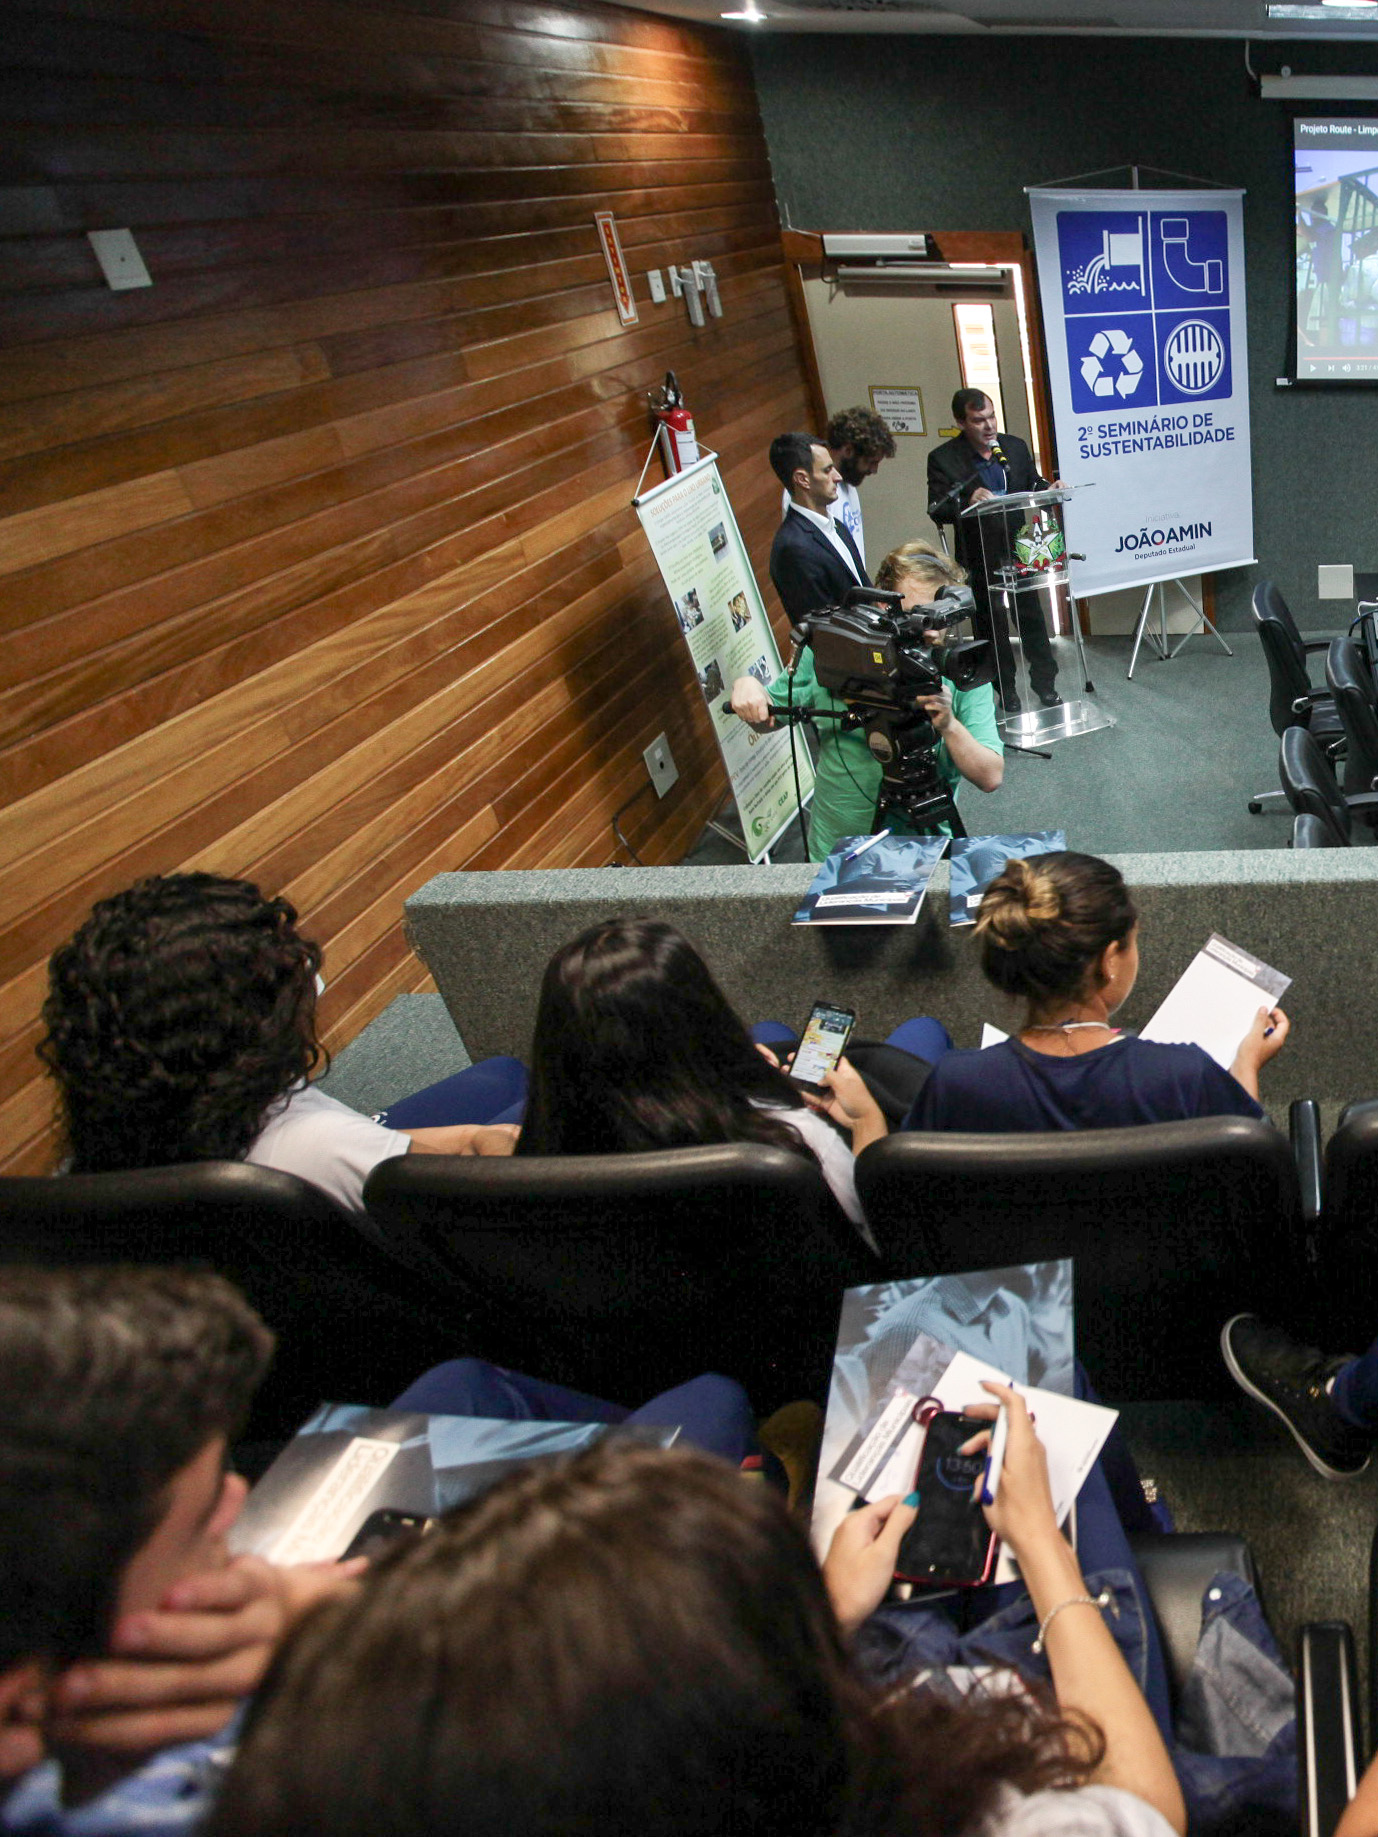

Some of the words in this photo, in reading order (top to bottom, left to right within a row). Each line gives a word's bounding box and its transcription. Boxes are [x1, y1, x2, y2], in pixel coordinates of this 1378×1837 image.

[1300, 124, 1328, 135] Projeto
[1329, 125, 1352, 134] Route
[1077, 425, 1093, 442] 2º
[1097, 415, 1189, 439] SEMINÁRIO
[1192, 412, 1213, 428] DE
[1080, 427, 1235, 459] SUSTENTABILIDADE
[1134, 549, 1167, 560] Deputado
[1168, 543, 1196, 555] Estadual
